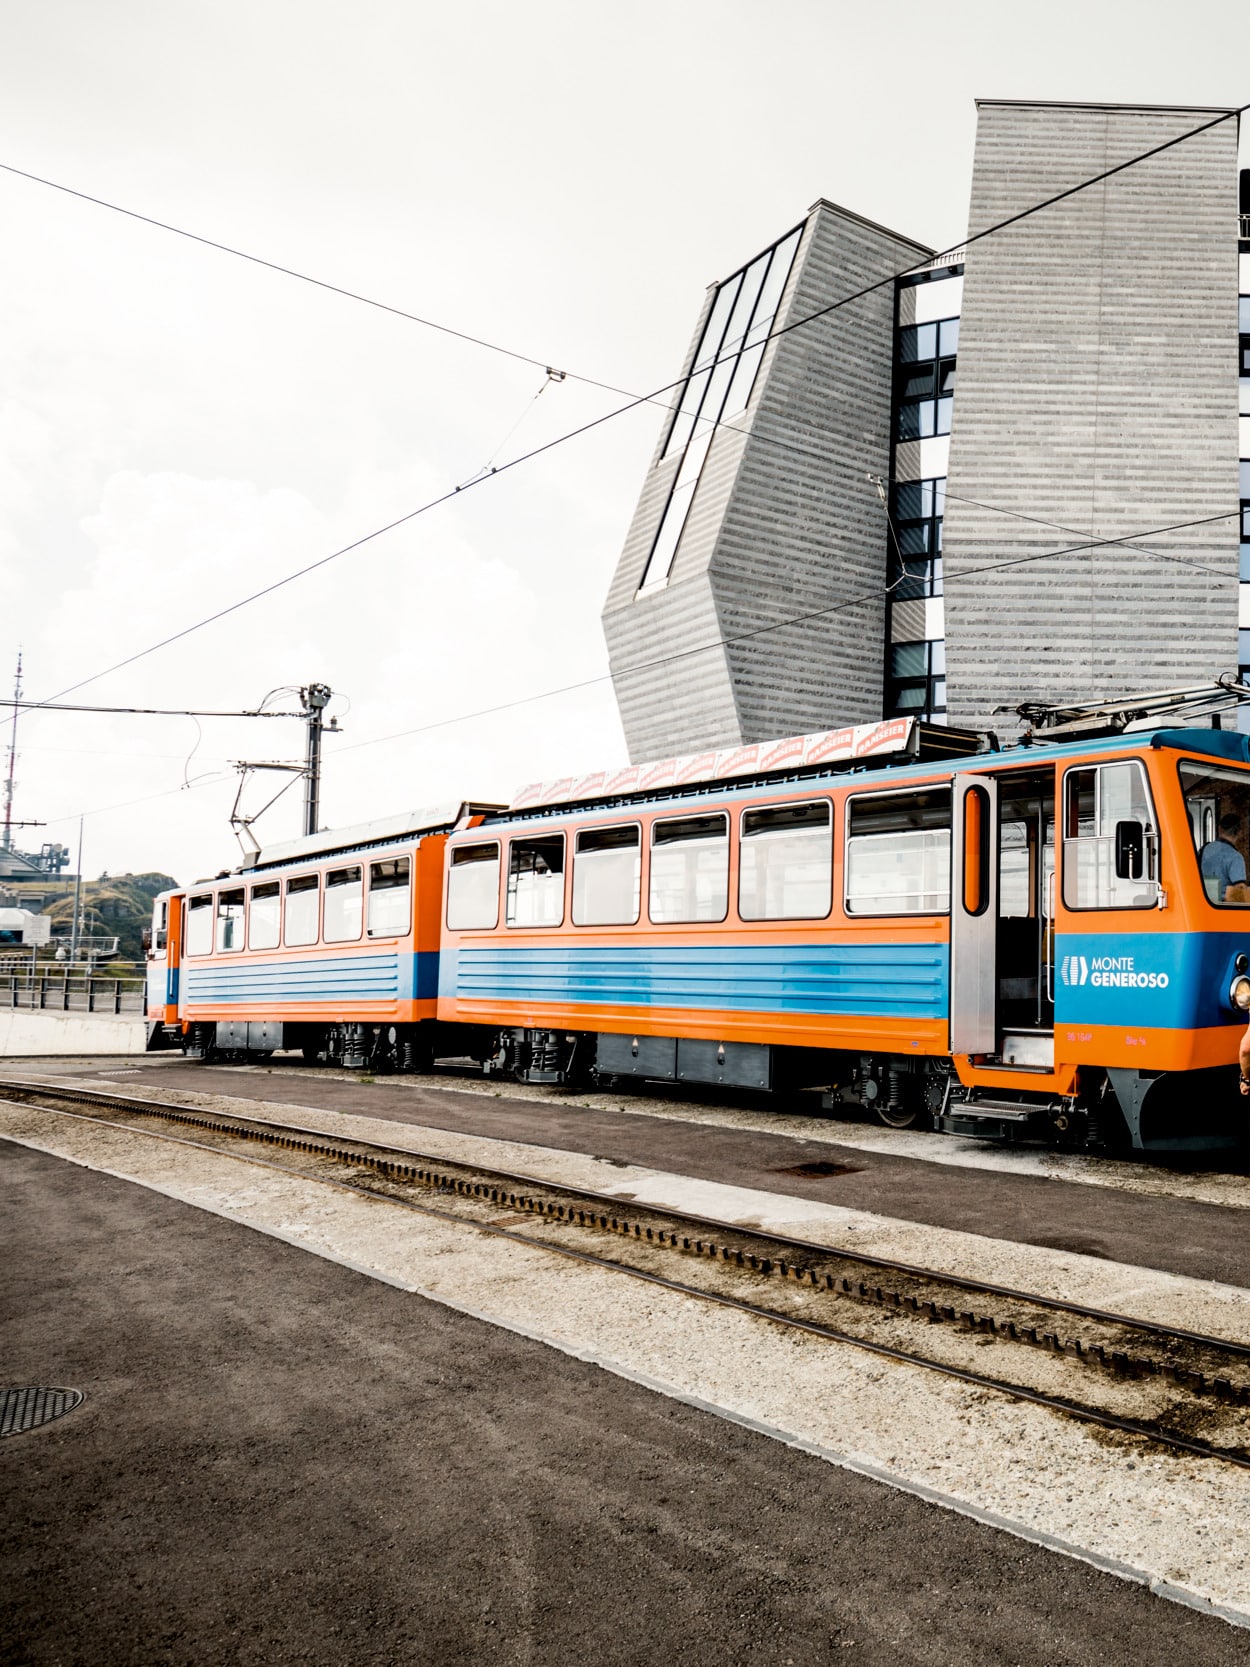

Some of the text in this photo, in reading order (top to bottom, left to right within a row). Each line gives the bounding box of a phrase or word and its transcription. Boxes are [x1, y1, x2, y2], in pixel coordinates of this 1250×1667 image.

[808, 733, 852, 764] RAMSEIER
[858, 724, 904, 756] RAMSEIER
[762, 742, 802, 769] RAMSEIER
[1091, 957, 1134, 971] MONTE
[1091, 972, 1169, 988] GENEROSO
